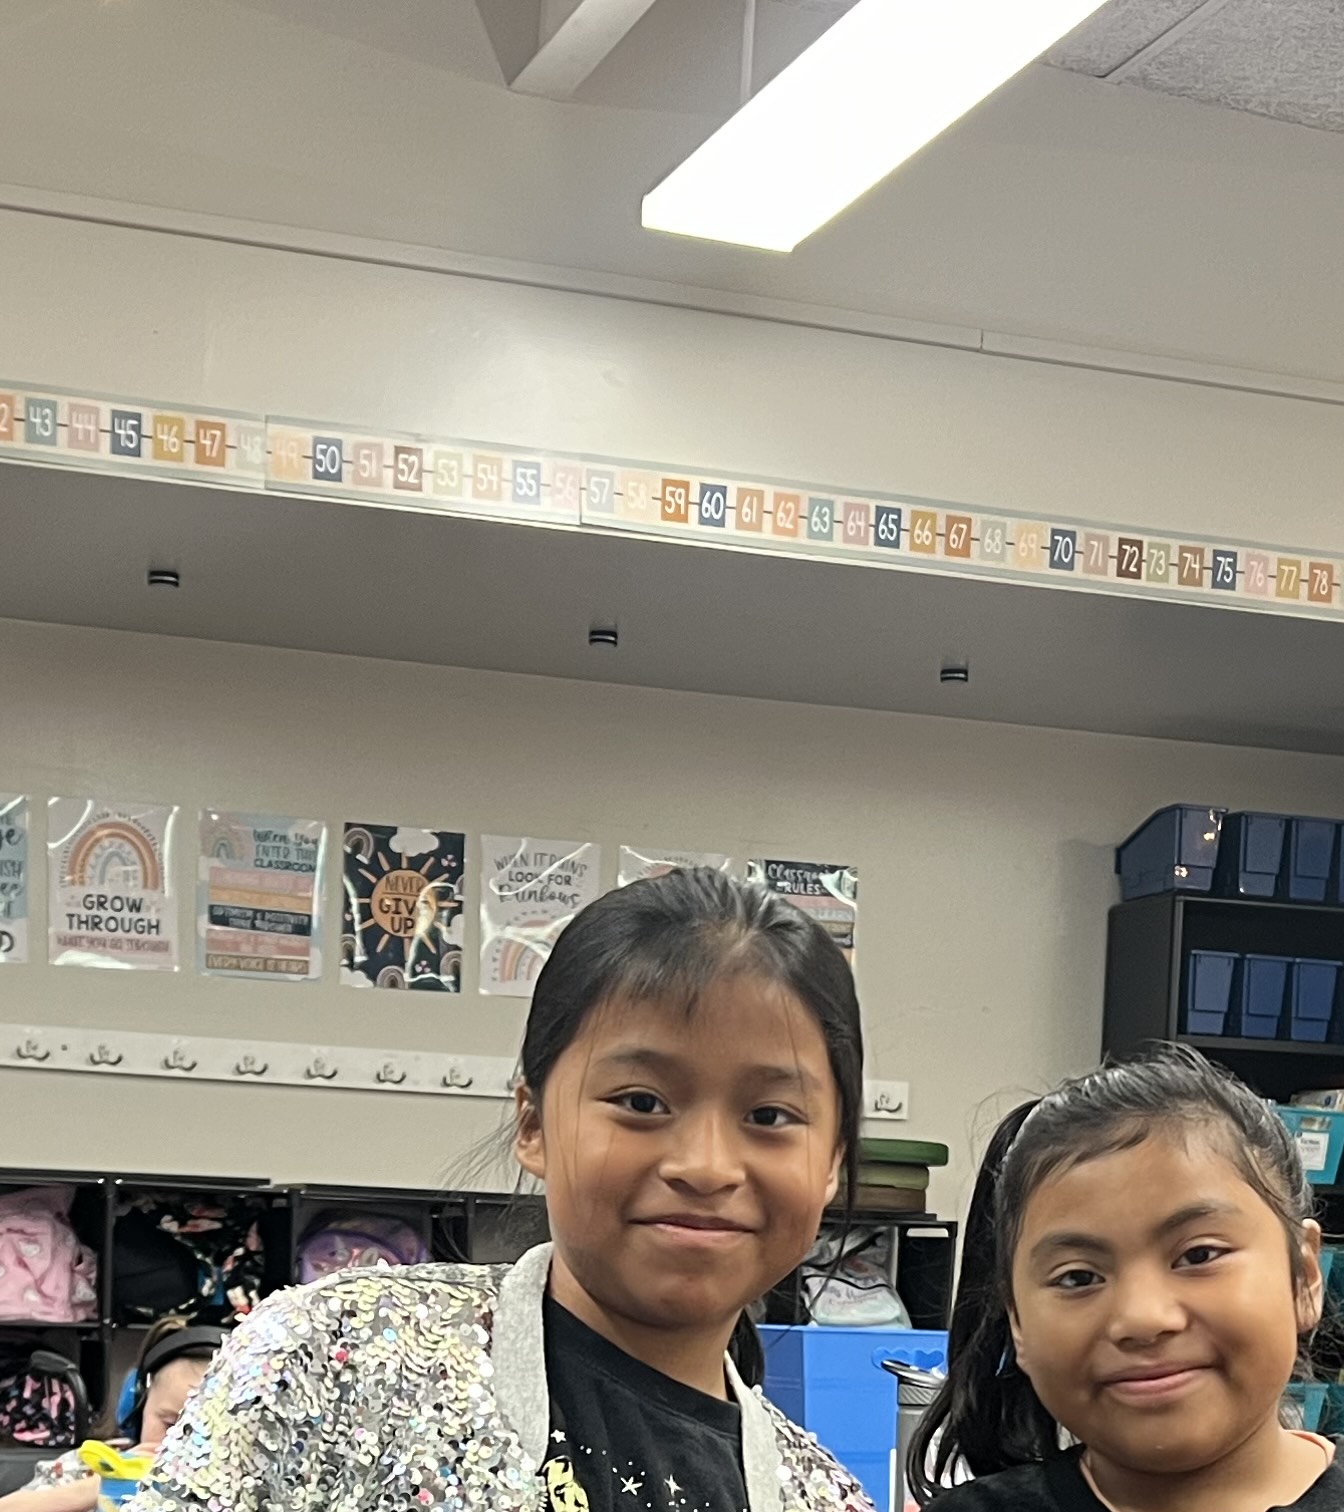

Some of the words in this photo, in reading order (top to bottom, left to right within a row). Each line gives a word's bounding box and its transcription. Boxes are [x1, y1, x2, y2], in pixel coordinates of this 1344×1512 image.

[30, 407, 52, 436] 43
[72, 413, 96, 442] 44
[115, 419, 139, 448] 45
[157, 425, 180, 453] 46
[200, 429, 221, 457] 47
[315, 444, 340, 473] 50
[360, 450, 377, 478] 51
[398, 454, 419, 483] 52
[437, 460, 458, 488] 53
[477, 463, 498, 491] 54
[517, 468, 537, 496] 55
[590, 478, 610, 504] 57
[665, 487, 685, 515] 59
[701, 492, 723, 519] 60
[742, 496, 756, 523] 61
[776, 502, 794, 529] 62
[811, 505, 830, 532] 63
[847, 510, 865, 536] 64
[878, 513, 897, 540] 65
[913, 519, 932, 545] 66
[949, 524, 967, 550] 67
[984, 528, 1002, 554] 68
[1018, 533, 1036, 558] 69
[1053, 536, 1072, 563] 70
[1090, 541, 1103, 567] 71
[1121, 545, 1138, 572] 72
[1149, 549, 1165, 575] 73
[1183, 553, 1200, 579] 74
[1216, 557, 1233, 583] 75
[1249, 561, 1265, 587] 76
[1280, 565, 1297, 591] 77
[1312, 569, 1328, 595] 78
[548, 873, 572, 886] FOR
[82, 894, 144, 913] GROW
[378, 898, 428, 915] GIV
[66, 913, 160, 935] THROUGH
[390, 917, 415, 934] UP
